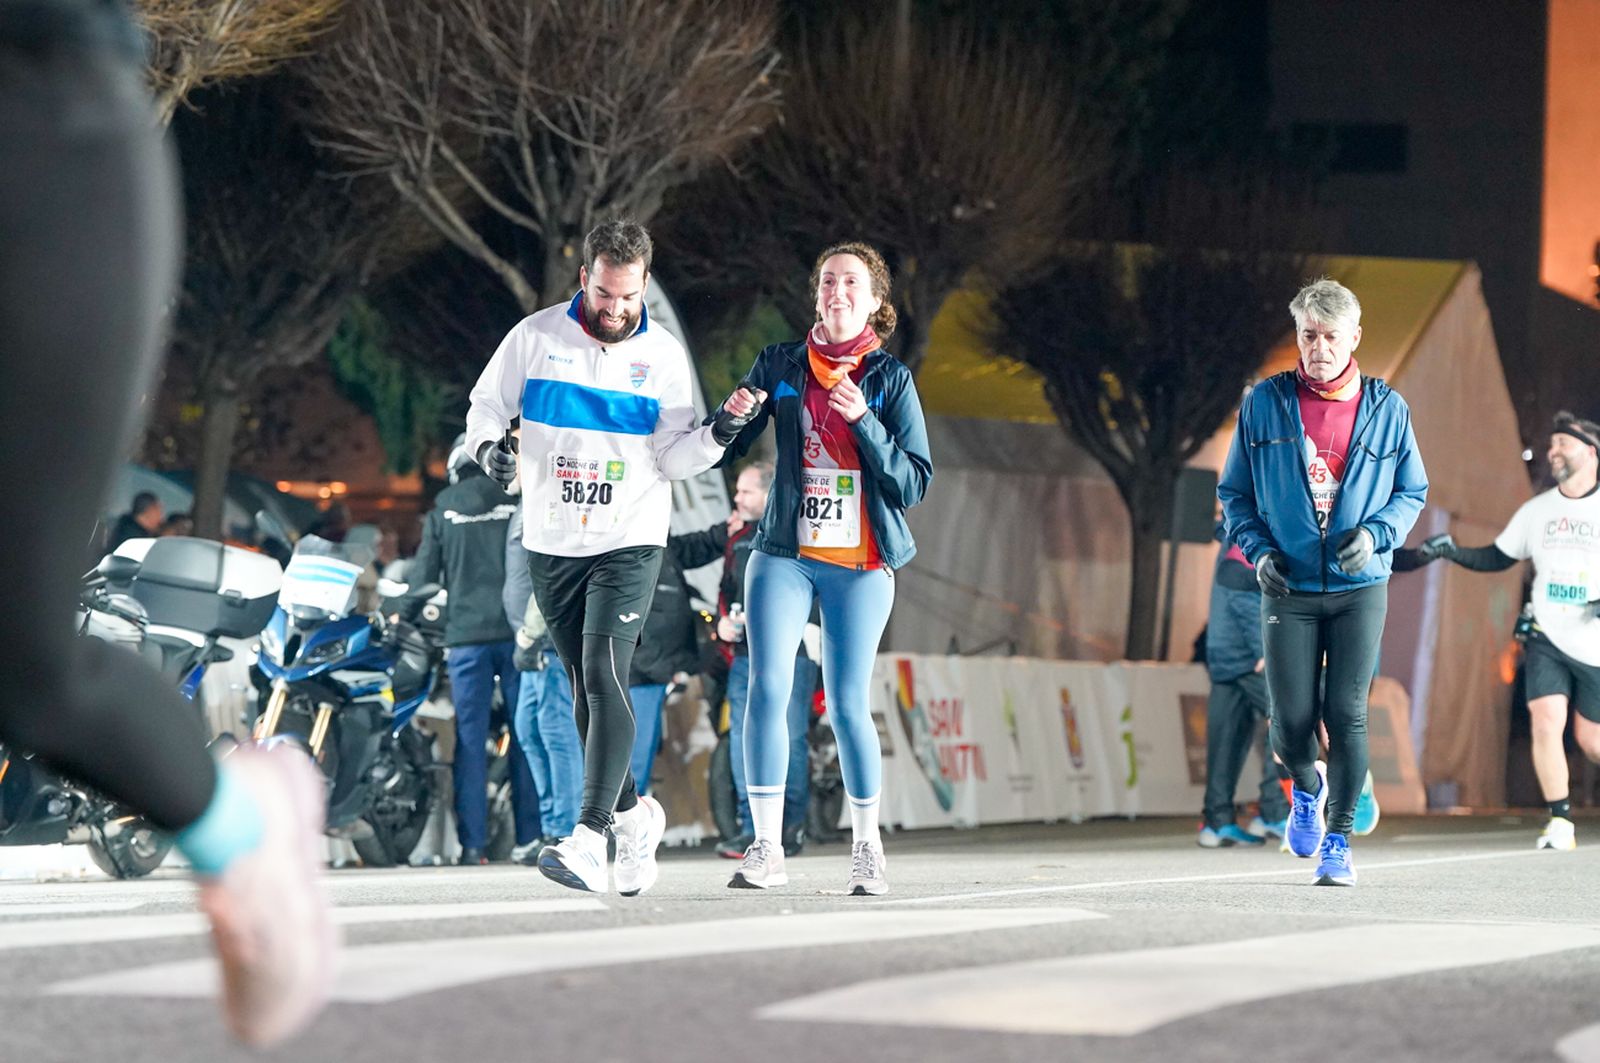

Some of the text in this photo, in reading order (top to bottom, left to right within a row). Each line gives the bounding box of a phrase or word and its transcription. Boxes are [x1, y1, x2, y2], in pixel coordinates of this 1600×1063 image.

[556, 470, 572, 478] SAN
[1308, 463, 1327, 483] 43
[820, 478, 830, 486] DE
[561, 480, 613, 505] 5820
[1549, 584, 1587, 599] 13509
